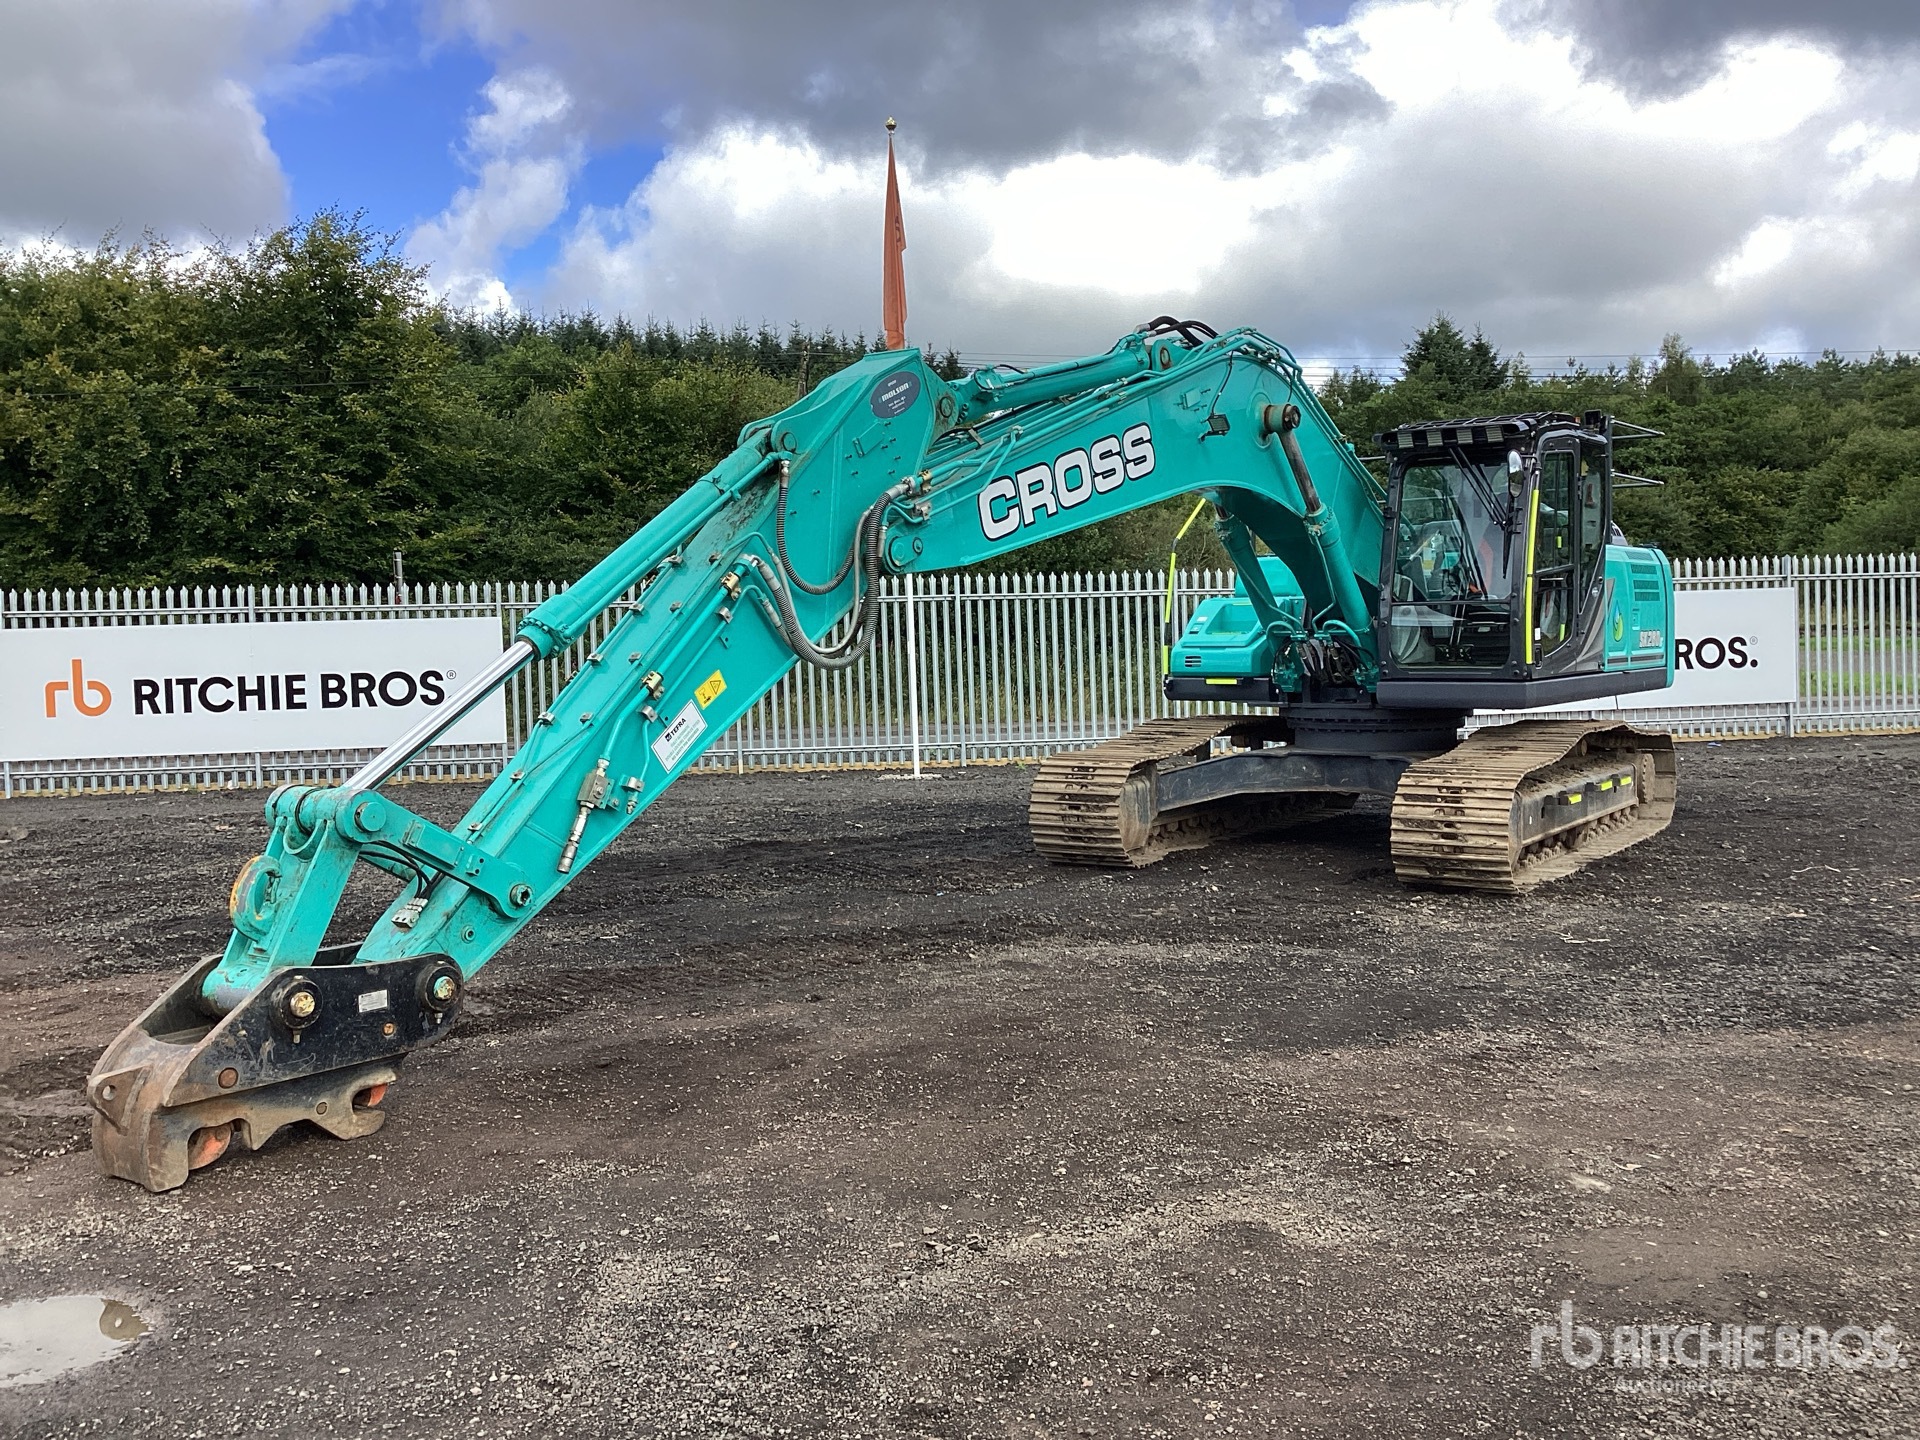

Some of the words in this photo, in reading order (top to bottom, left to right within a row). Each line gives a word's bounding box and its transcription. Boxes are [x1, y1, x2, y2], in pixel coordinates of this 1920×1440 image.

[978, 422, 1156, 542] CROSS
[1675, 636, 1759, 669] ROS.
[45, 659, 112, 718] rb
[133, 674, 307, 715] RITCHIE
